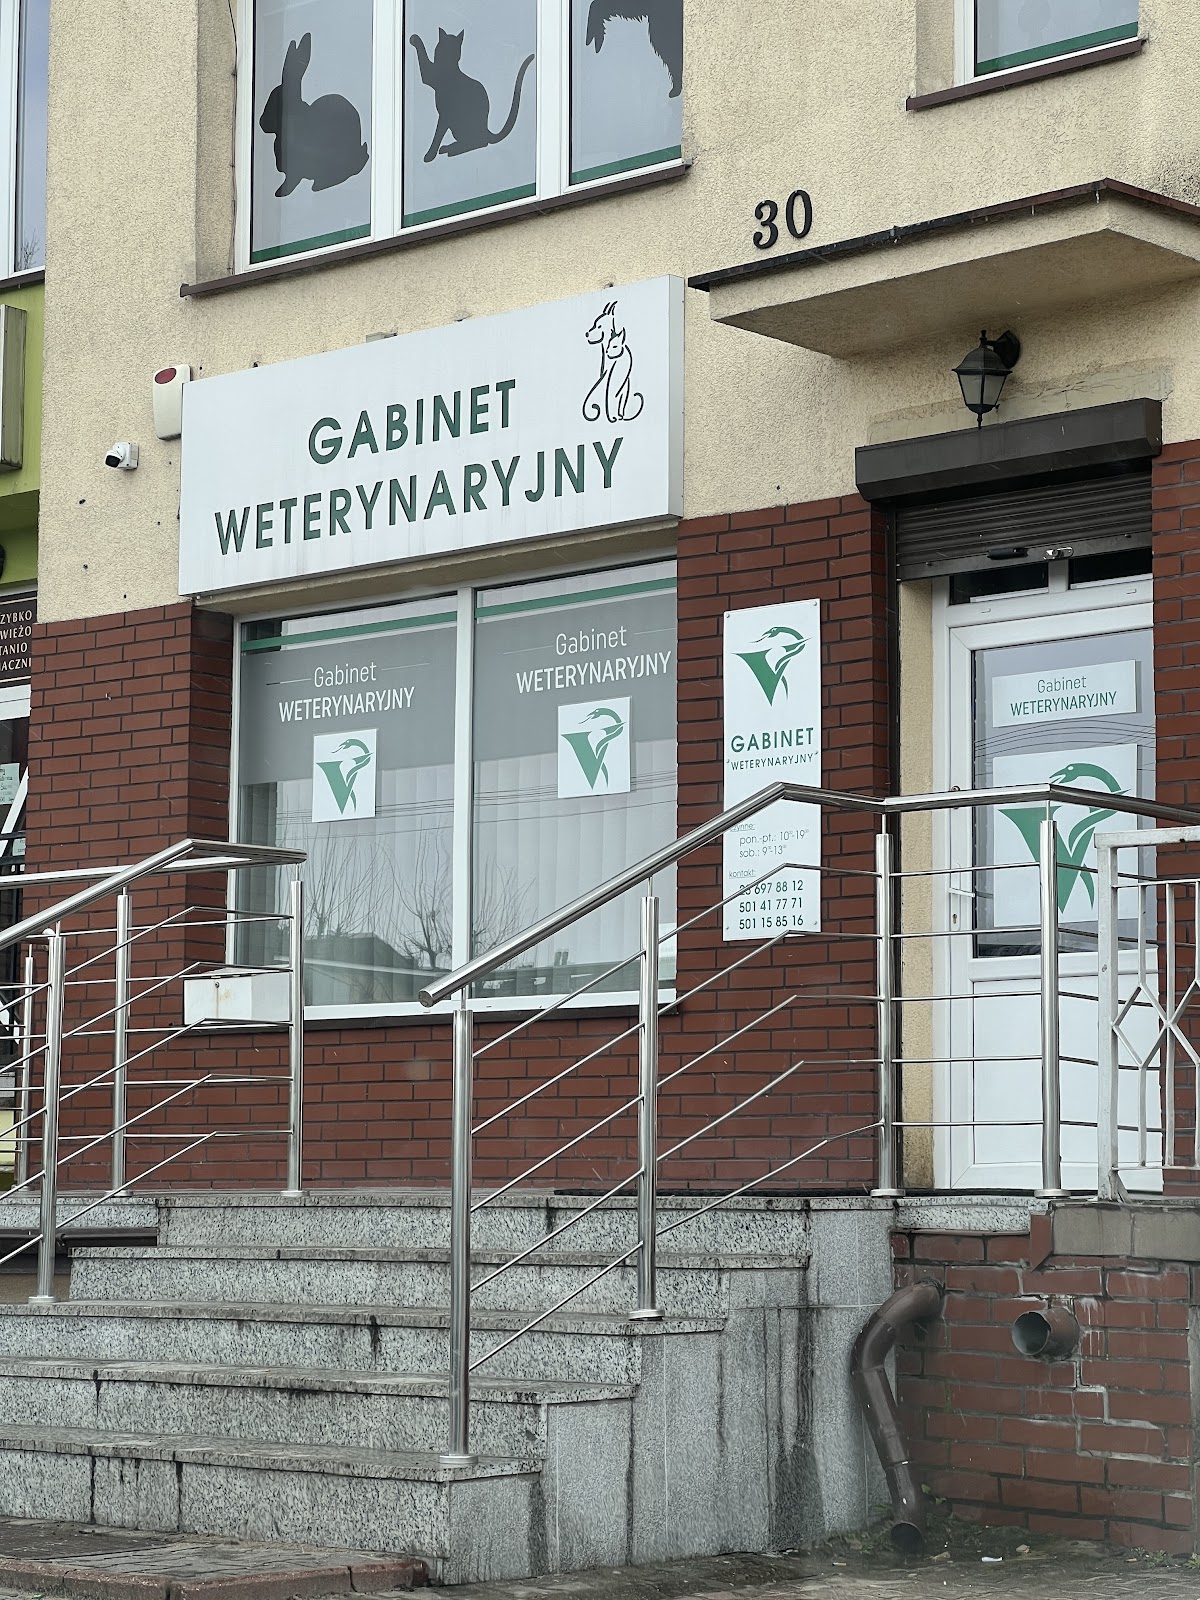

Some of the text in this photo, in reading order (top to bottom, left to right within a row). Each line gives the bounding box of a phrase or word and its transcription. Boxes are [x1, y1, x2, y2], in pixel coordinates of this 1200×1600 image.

[753, 190, 812, 250] 30
[308, 379, 516, 464] GABINET
[215, 437, 624, 556] WETERYNARYJNY
[555, 626, 627, 656] Gabinet
[0, 658, 31, 671] ACZNI
[314, 661, 377, 688] Gabinet
[516, 650, 672, 694] WETERYNARYJNY
[1037, 675, 1087, 693] Gabinet
[278, 687, 415, 723] WETERYNARYJNY
[1010, 690, 1117, 717] WETERYNARYJNY
[731, 727, 814, 753] GABINET
[731, 753, 814, 771] WETERYNARYJNY
[754, 882, 773, 895] 697
[775, 881, 788, 893] 88
[792, 879, 803, 892] 12
[739, 897, 802, 913] 501 41 77 71
[739, 914, 804, 930] 501 15 85 16
